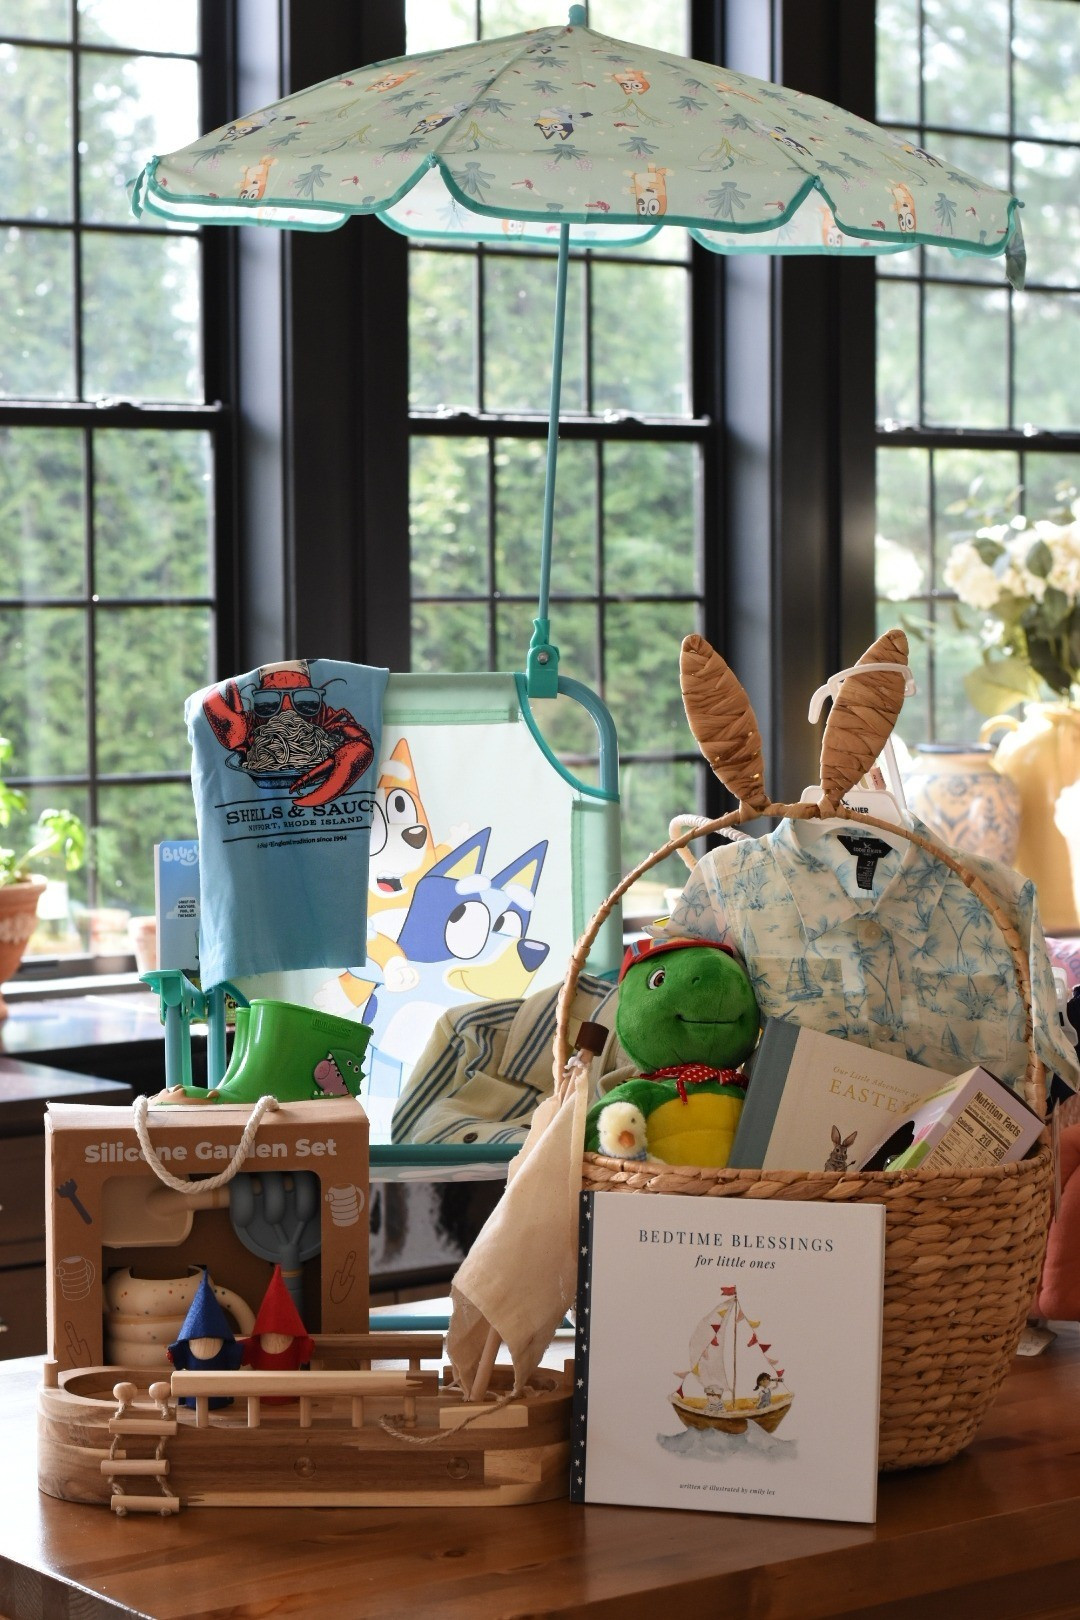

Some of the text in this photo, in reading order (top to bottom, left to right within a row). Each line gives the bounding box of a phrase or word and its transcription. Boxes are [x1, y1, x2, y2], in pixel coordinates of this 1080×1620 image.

[226, 806, 284, 825] SHELLS
[288, 804, 306, 818] &
[283, 820, 316, 828] RHODE
[320, 816, 363, 826] ISLAND
[833, 1066, 848, 1076] Our
[850, 1072, 870, 1082] Little
[974, 1091, 1003, 1121] Nutrition
[1002, 1117, 1021, 1137] Facts
[295, 1138, 337, 1156] Set
[958, 1117, 975, 1133] Calories
[979, 1135, 992, 1147] 210
[993, 1148, 1005, 1160] 430
[639, 1230, 834, 1252] BEDTIME BLESSINGS
[694, 1255, 776, 1269] for little ones
